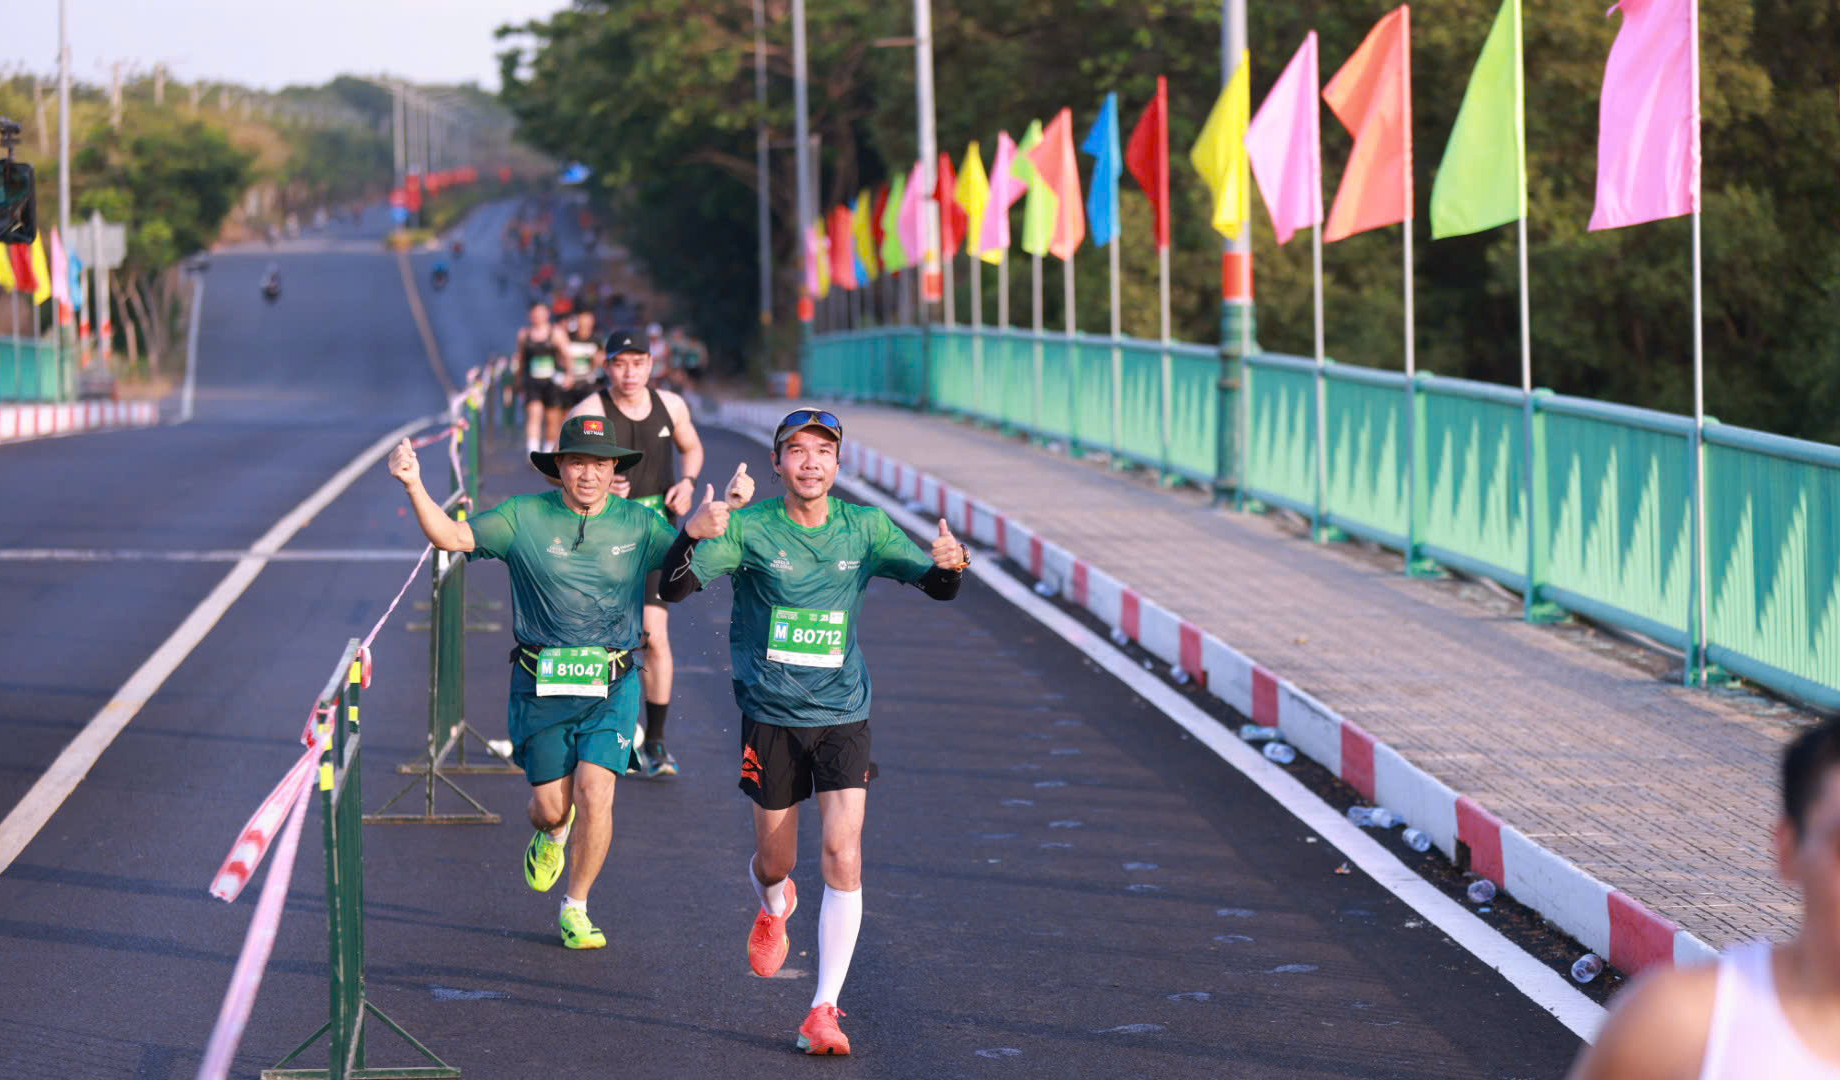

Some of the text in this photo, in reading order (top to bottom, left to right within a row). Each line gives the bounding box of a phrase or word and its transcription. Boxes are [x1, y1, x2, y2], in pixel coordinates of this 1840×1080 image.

[775, 624, 842, 645] M 80712
[543, 660, 603, 677] M 81047
